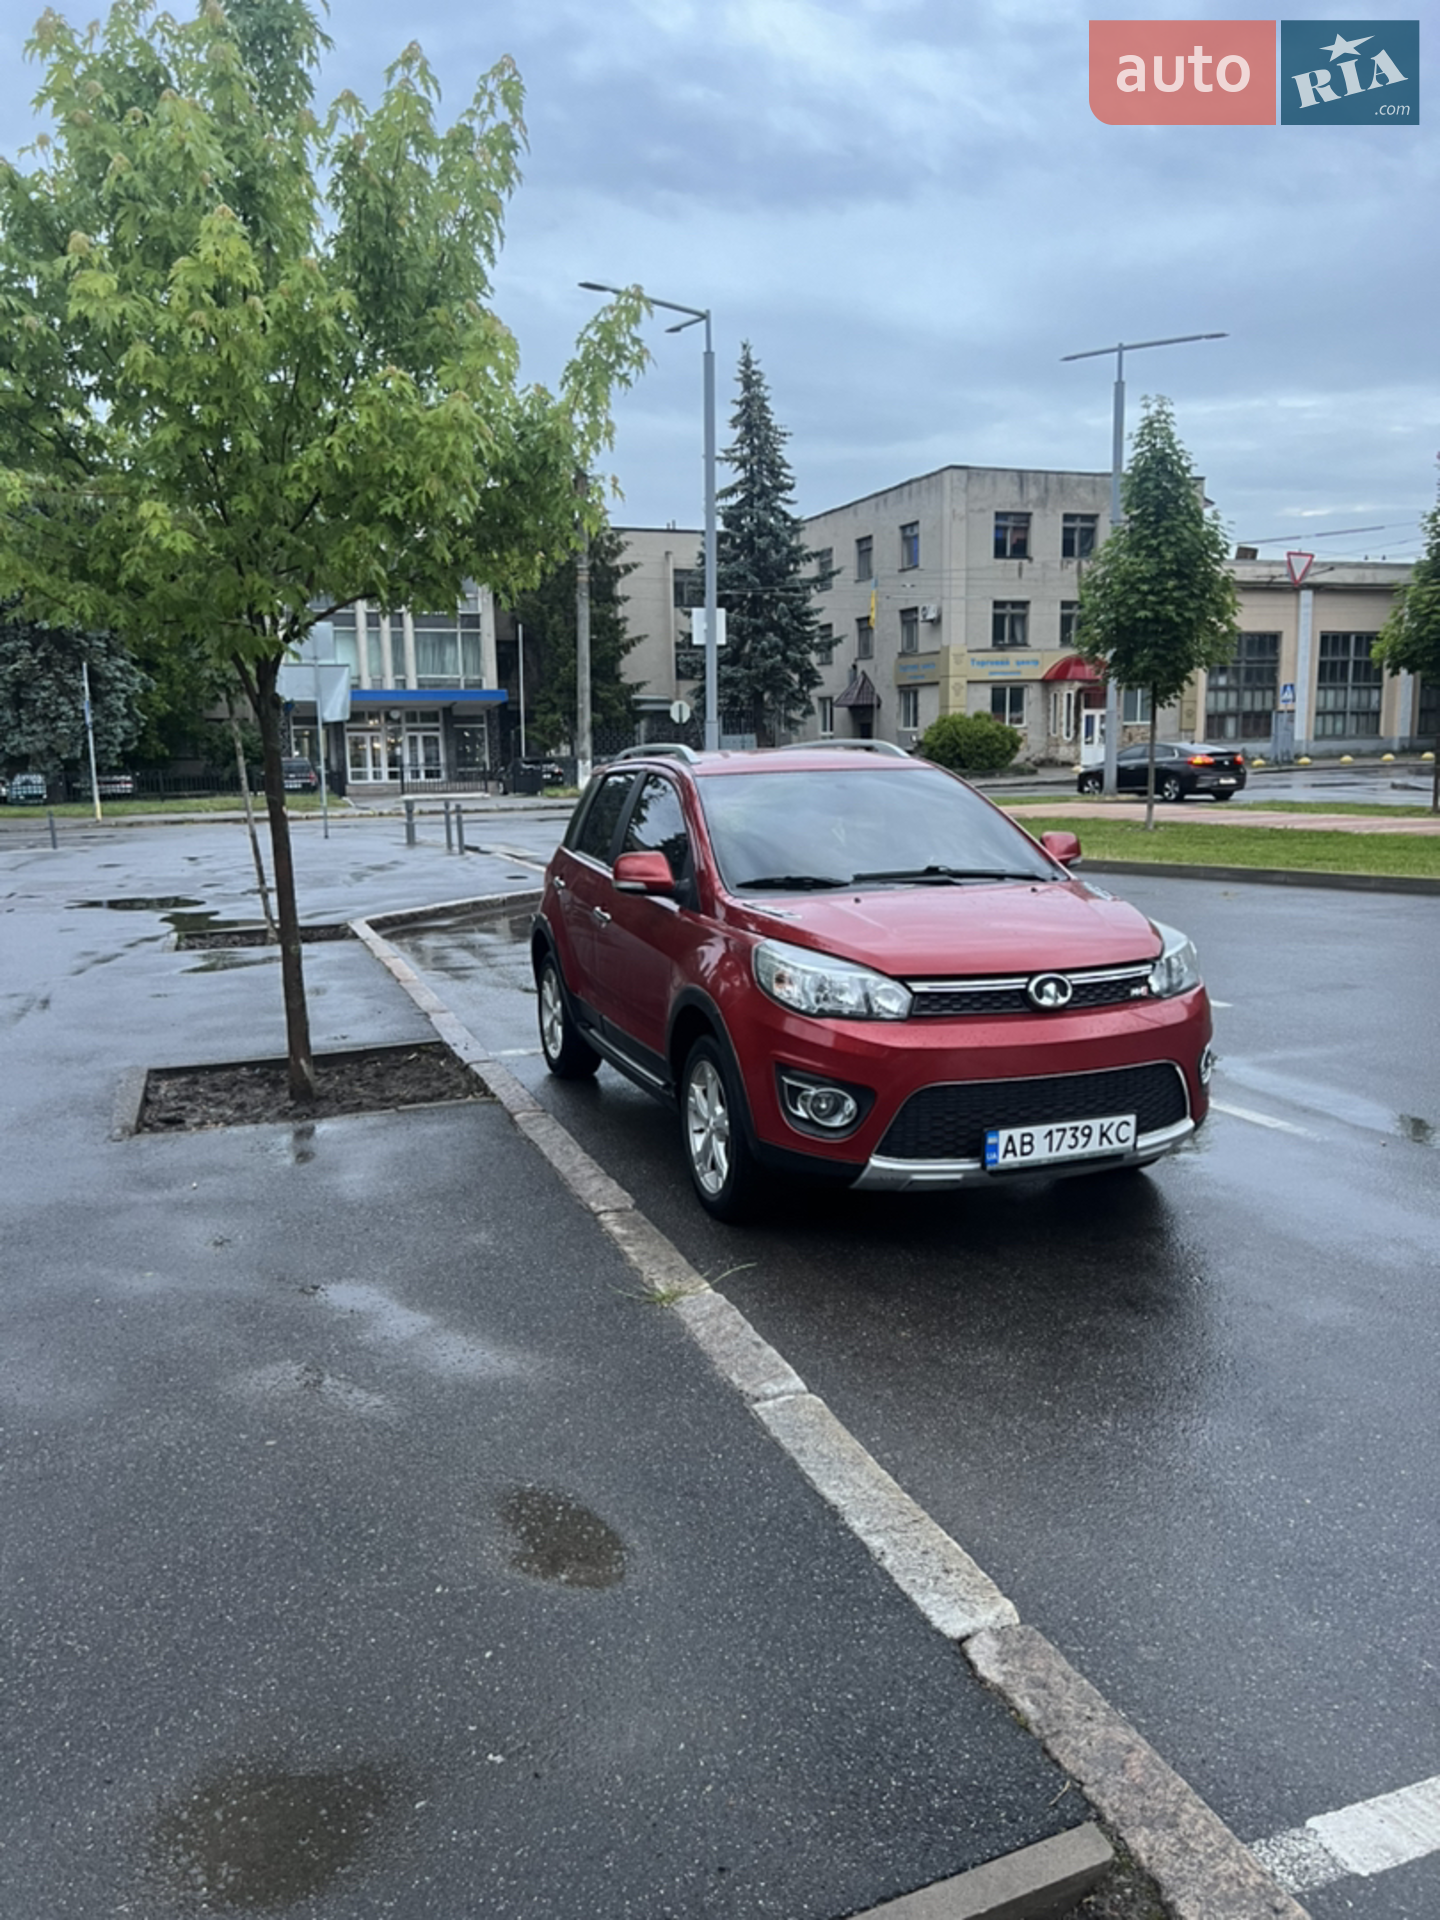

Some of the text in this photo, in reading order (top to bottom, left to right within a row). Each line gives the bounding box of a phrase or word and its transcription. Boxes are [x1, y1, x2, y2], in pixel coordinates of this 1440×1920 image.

[1002, 1120, 1131, 1159] AB 1739 KC
